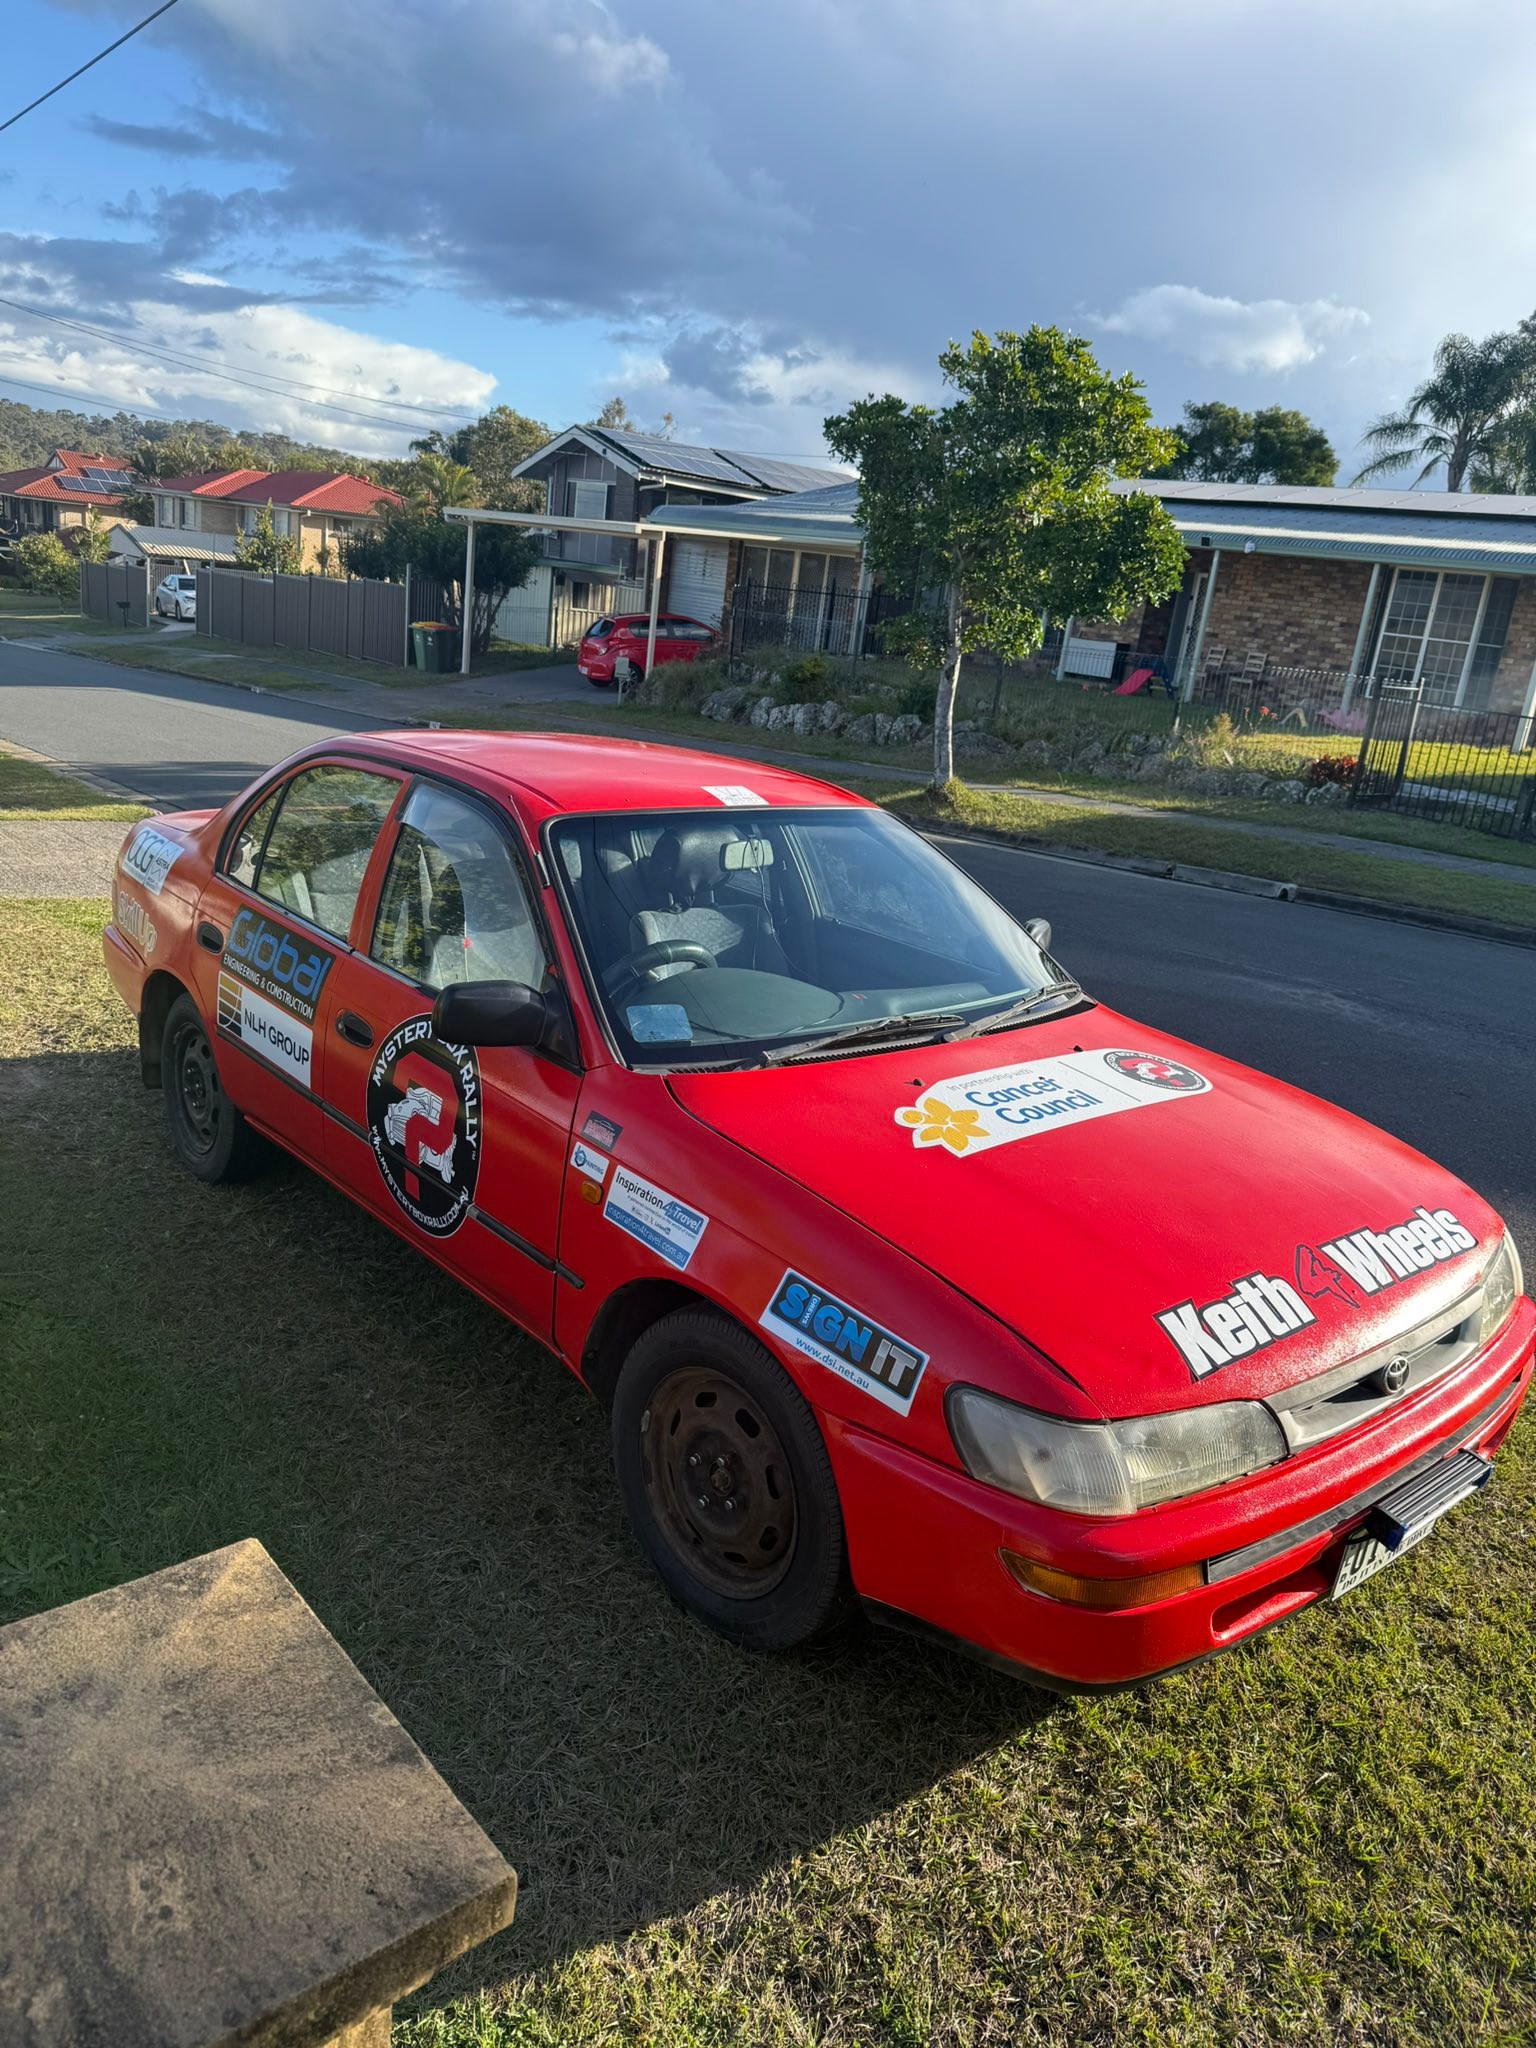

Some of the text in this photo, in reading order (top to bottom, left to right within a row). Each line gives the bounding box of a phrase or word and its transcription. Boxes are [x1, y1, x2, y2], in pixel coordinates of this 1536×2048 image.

[227, 910, 332, 1001] Global
[223, 953, 314, 1020] ENGINEERING & CONSTRUCTION
[244, 1008, 310, 1066] NLH GROUP
[459, 1060, 478, 1149] RALLY
[957, 1072, 1012, 1091] partnership
[965, 1078, 1064, 1107] Cancer
[995, 1089, 1103, 1124] Council
[607, 1203, 688, 1263] inspiration4travel.com.au
[1156, 1206, 1478, 1381] Keith 4 Wheels
[796, 1337, 870, 1389] www.dsi.net.au
[870, 1338, 918, 1387] IT
[1342, 1575, 1357, 1591] DO
[1360, 1566, 1371, 1579] IT
